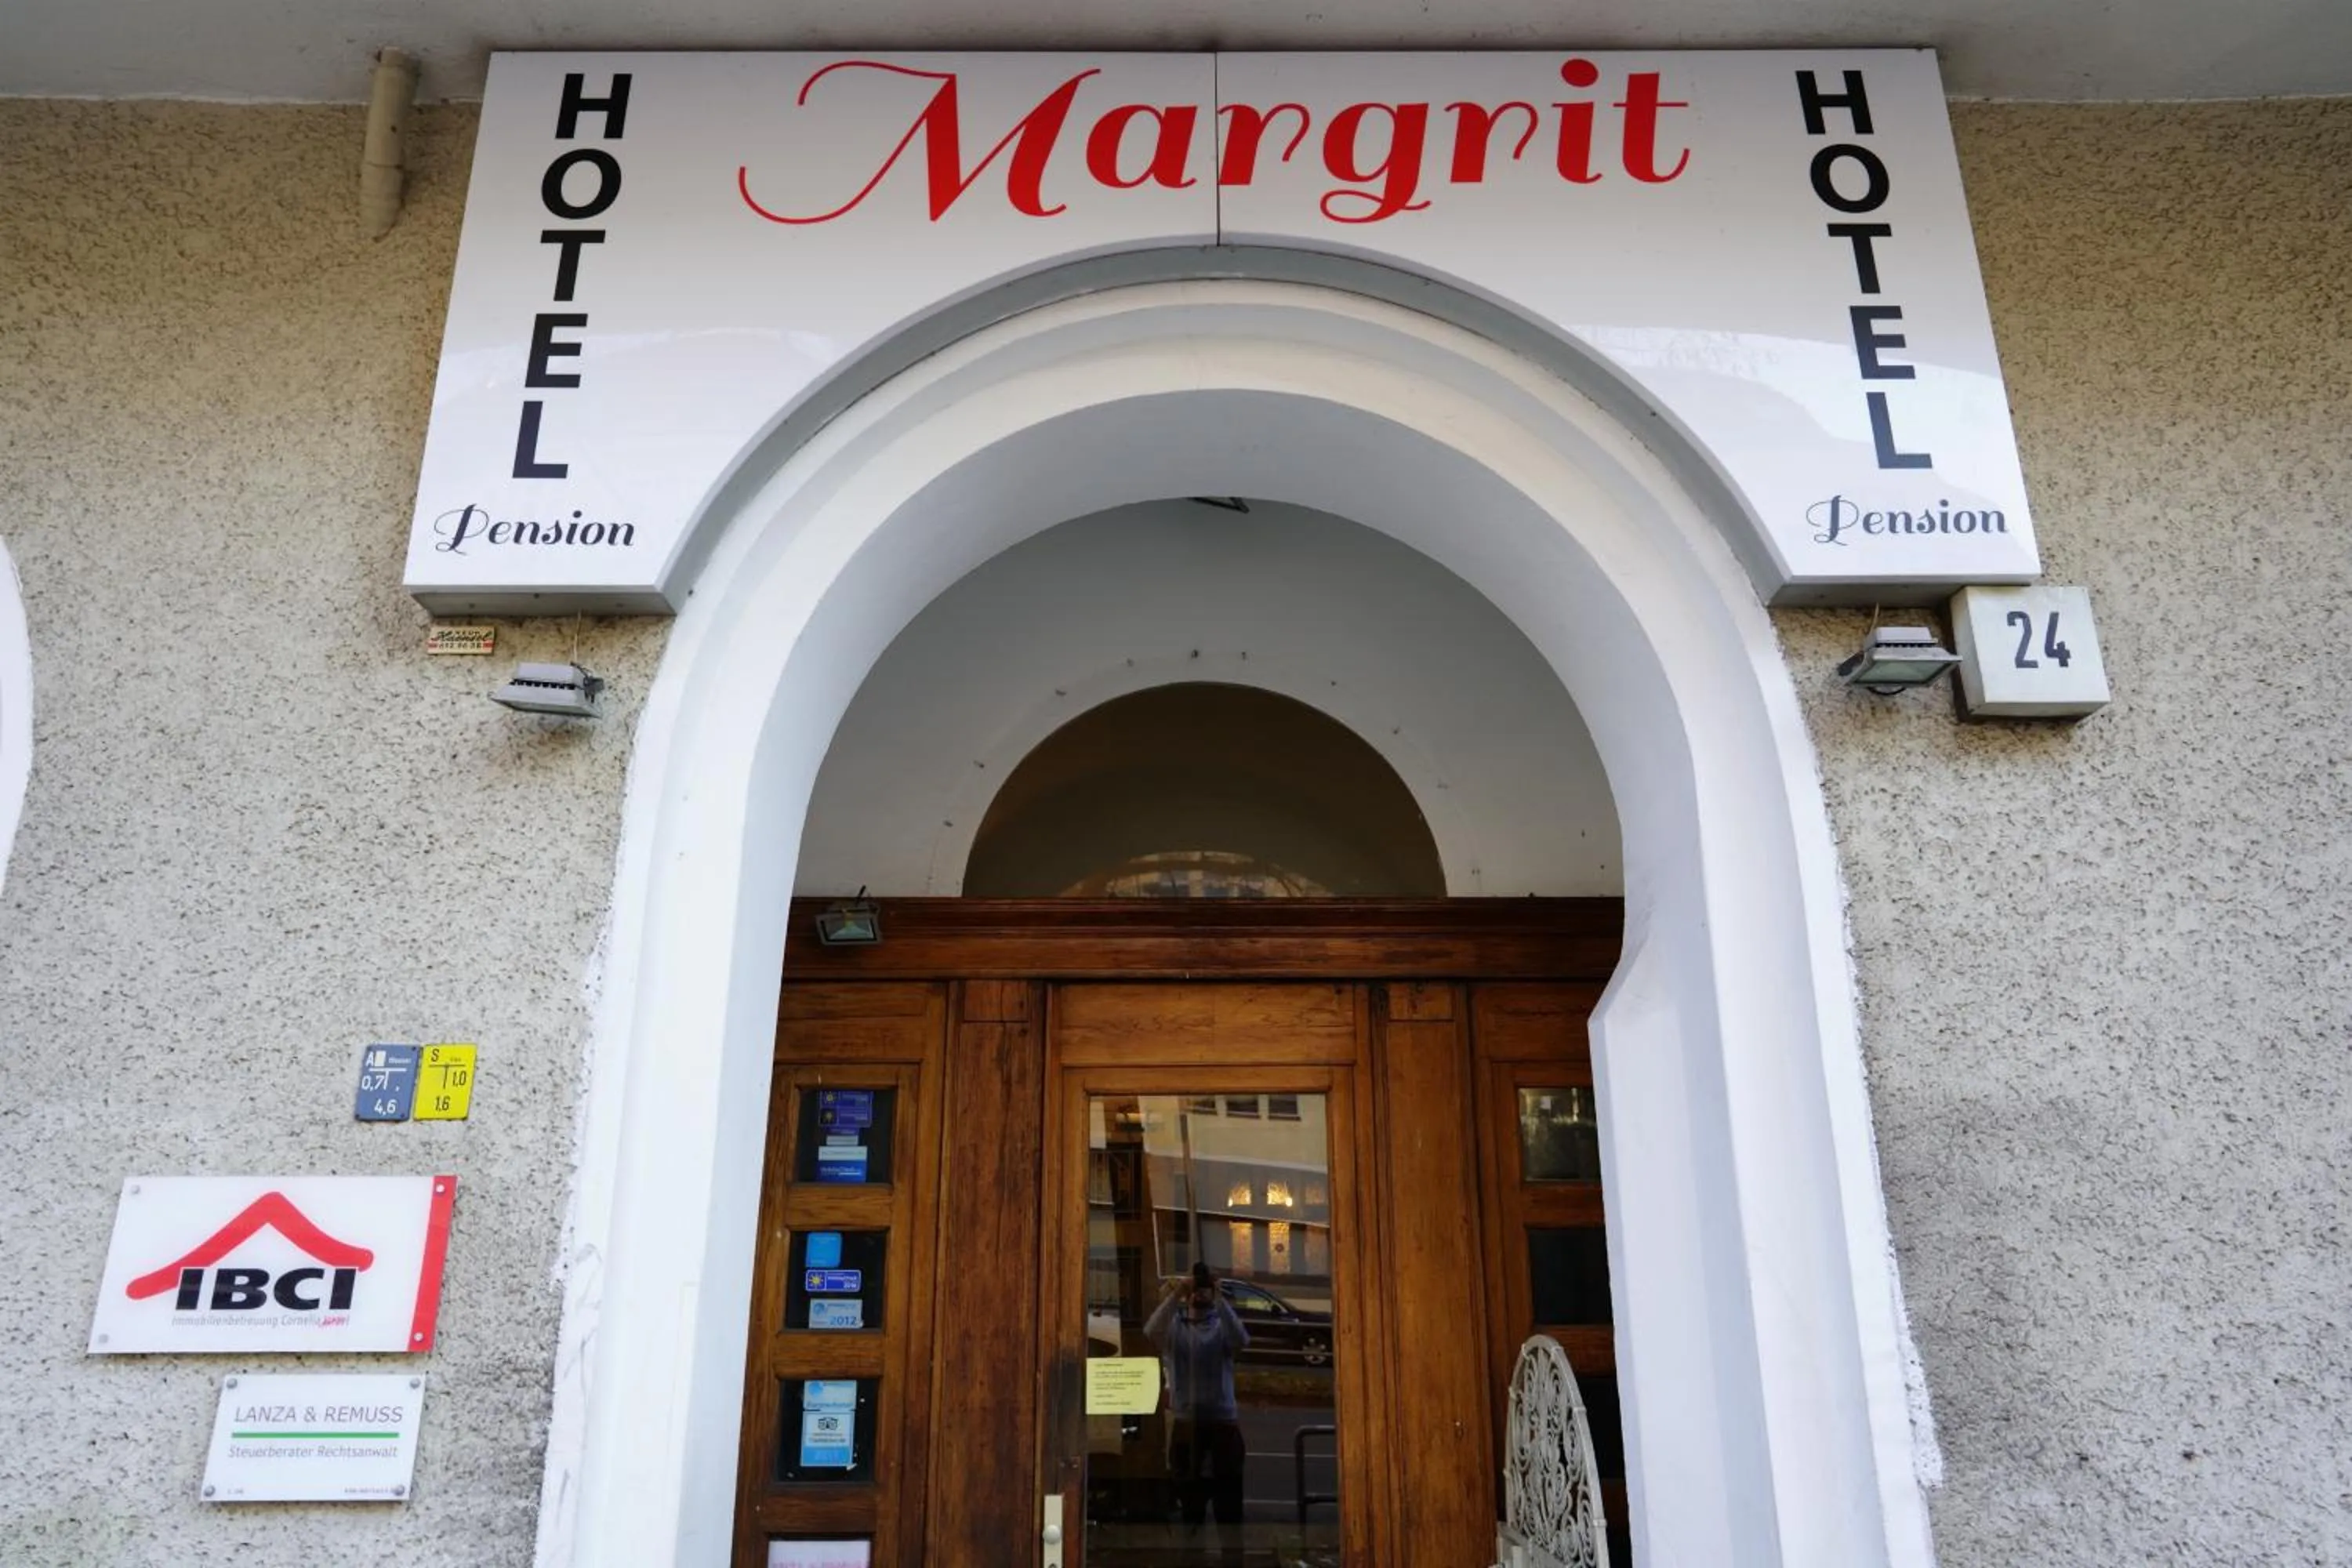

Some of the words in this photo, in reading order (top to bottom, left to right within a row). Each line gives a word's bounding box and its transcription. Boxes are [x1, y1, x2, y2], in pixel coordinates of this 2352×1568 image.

[739, 58, 1690, 224] Margrit
[512, 73, 633, 478] HOTEL
[1795, 70, 1933, 469] HOTEL
[434, 503, 635, 556] Pension
[1806, 494, 2009, 546] Pension
[2006, 609, 2072, 670] 24
[431, 1048, 440, 1062] S
[374, 1098, 397, 1116] 4,6
[176, 1268, 357, 1310] IBCI
[234, 1406, 297, 1423] LANZA
[303, 1406, 317, 1423] &
[324, 1406, 404, 1423] REMUSS
[228, 1445, 314, 1457] Steuerberater
[317, 1445, 398, 1457] Rechtsanwalt
